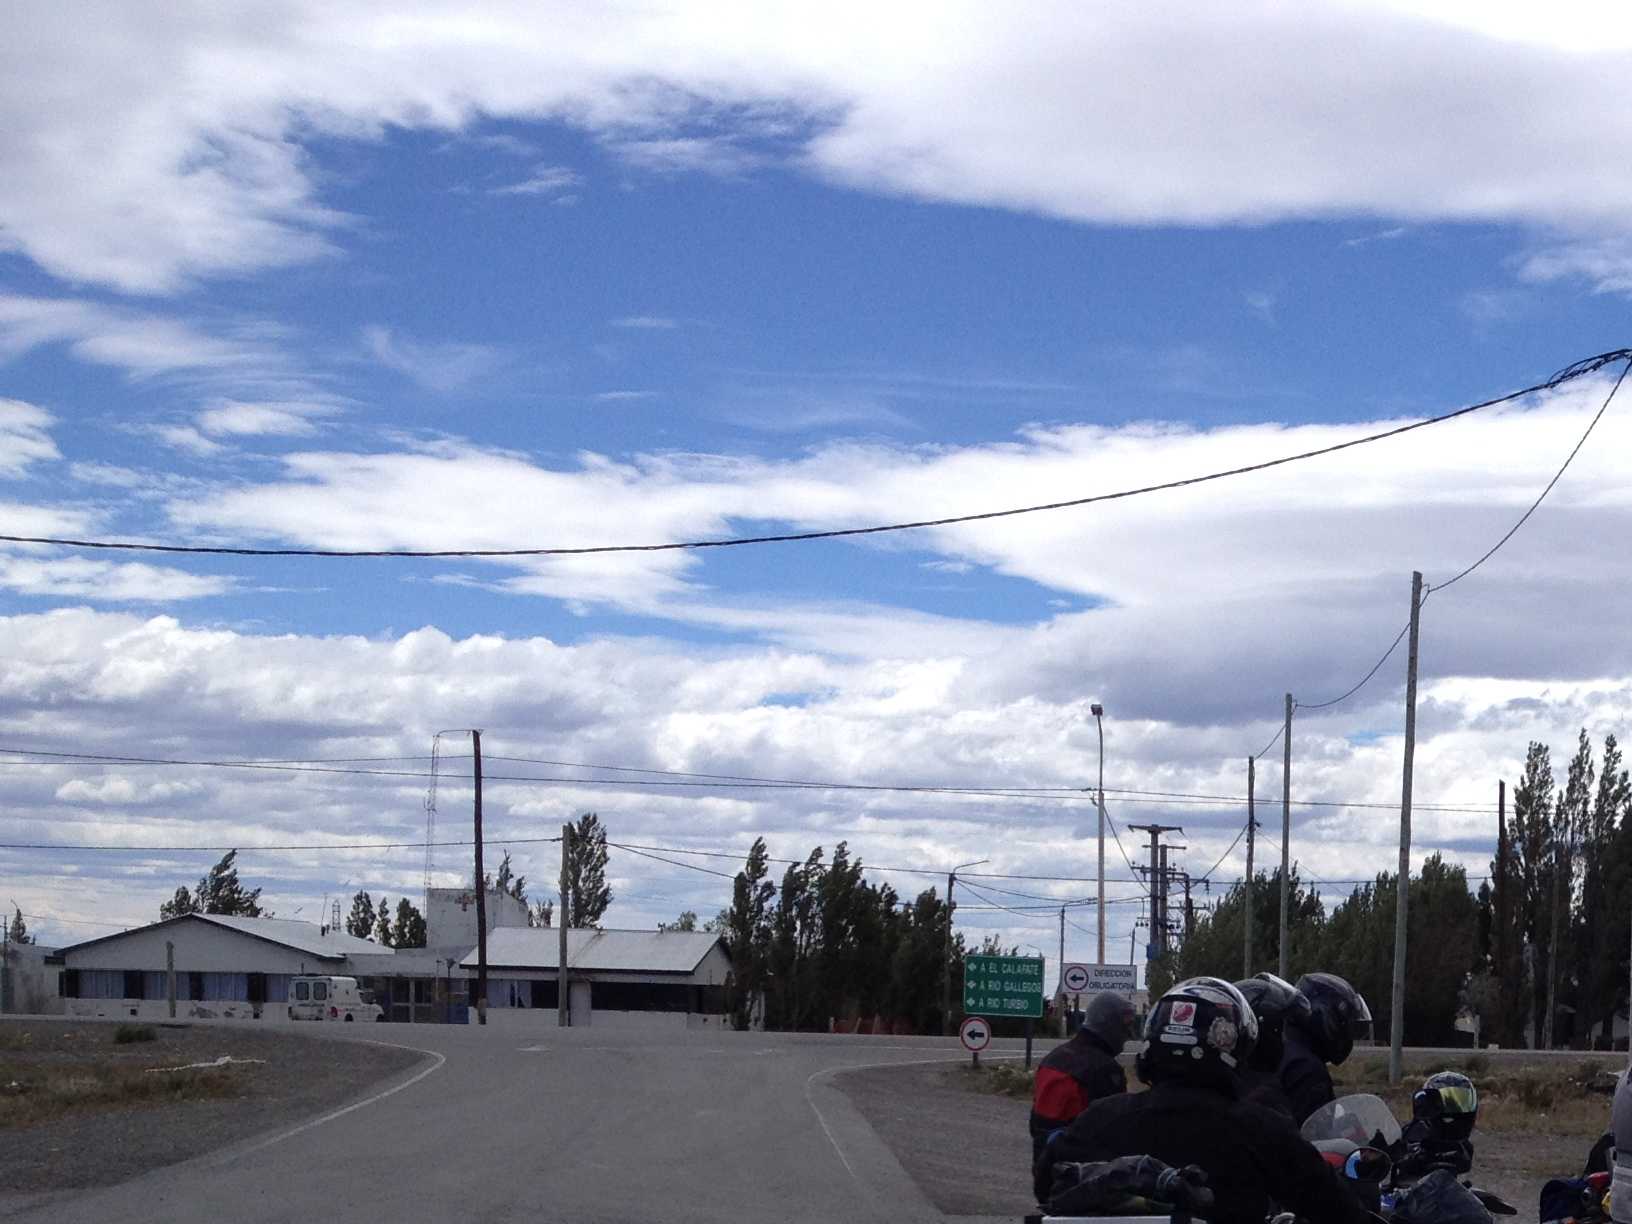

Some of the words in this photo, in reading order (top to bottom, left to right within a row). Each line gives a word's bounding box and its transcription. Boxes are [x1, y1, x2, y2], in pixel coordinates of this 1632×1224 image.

[980, 962, 986, 973] A
[989, 962, 998, 974] EL
[1002, 963, 1039, 976] CALAFATE
[979, 980, 985, 991] A
[1003, 981, 1041, 993] GALLEGOS
[978, 997, 984, 1008] A
[1003, 998, 1029, 1010] TURBIO
